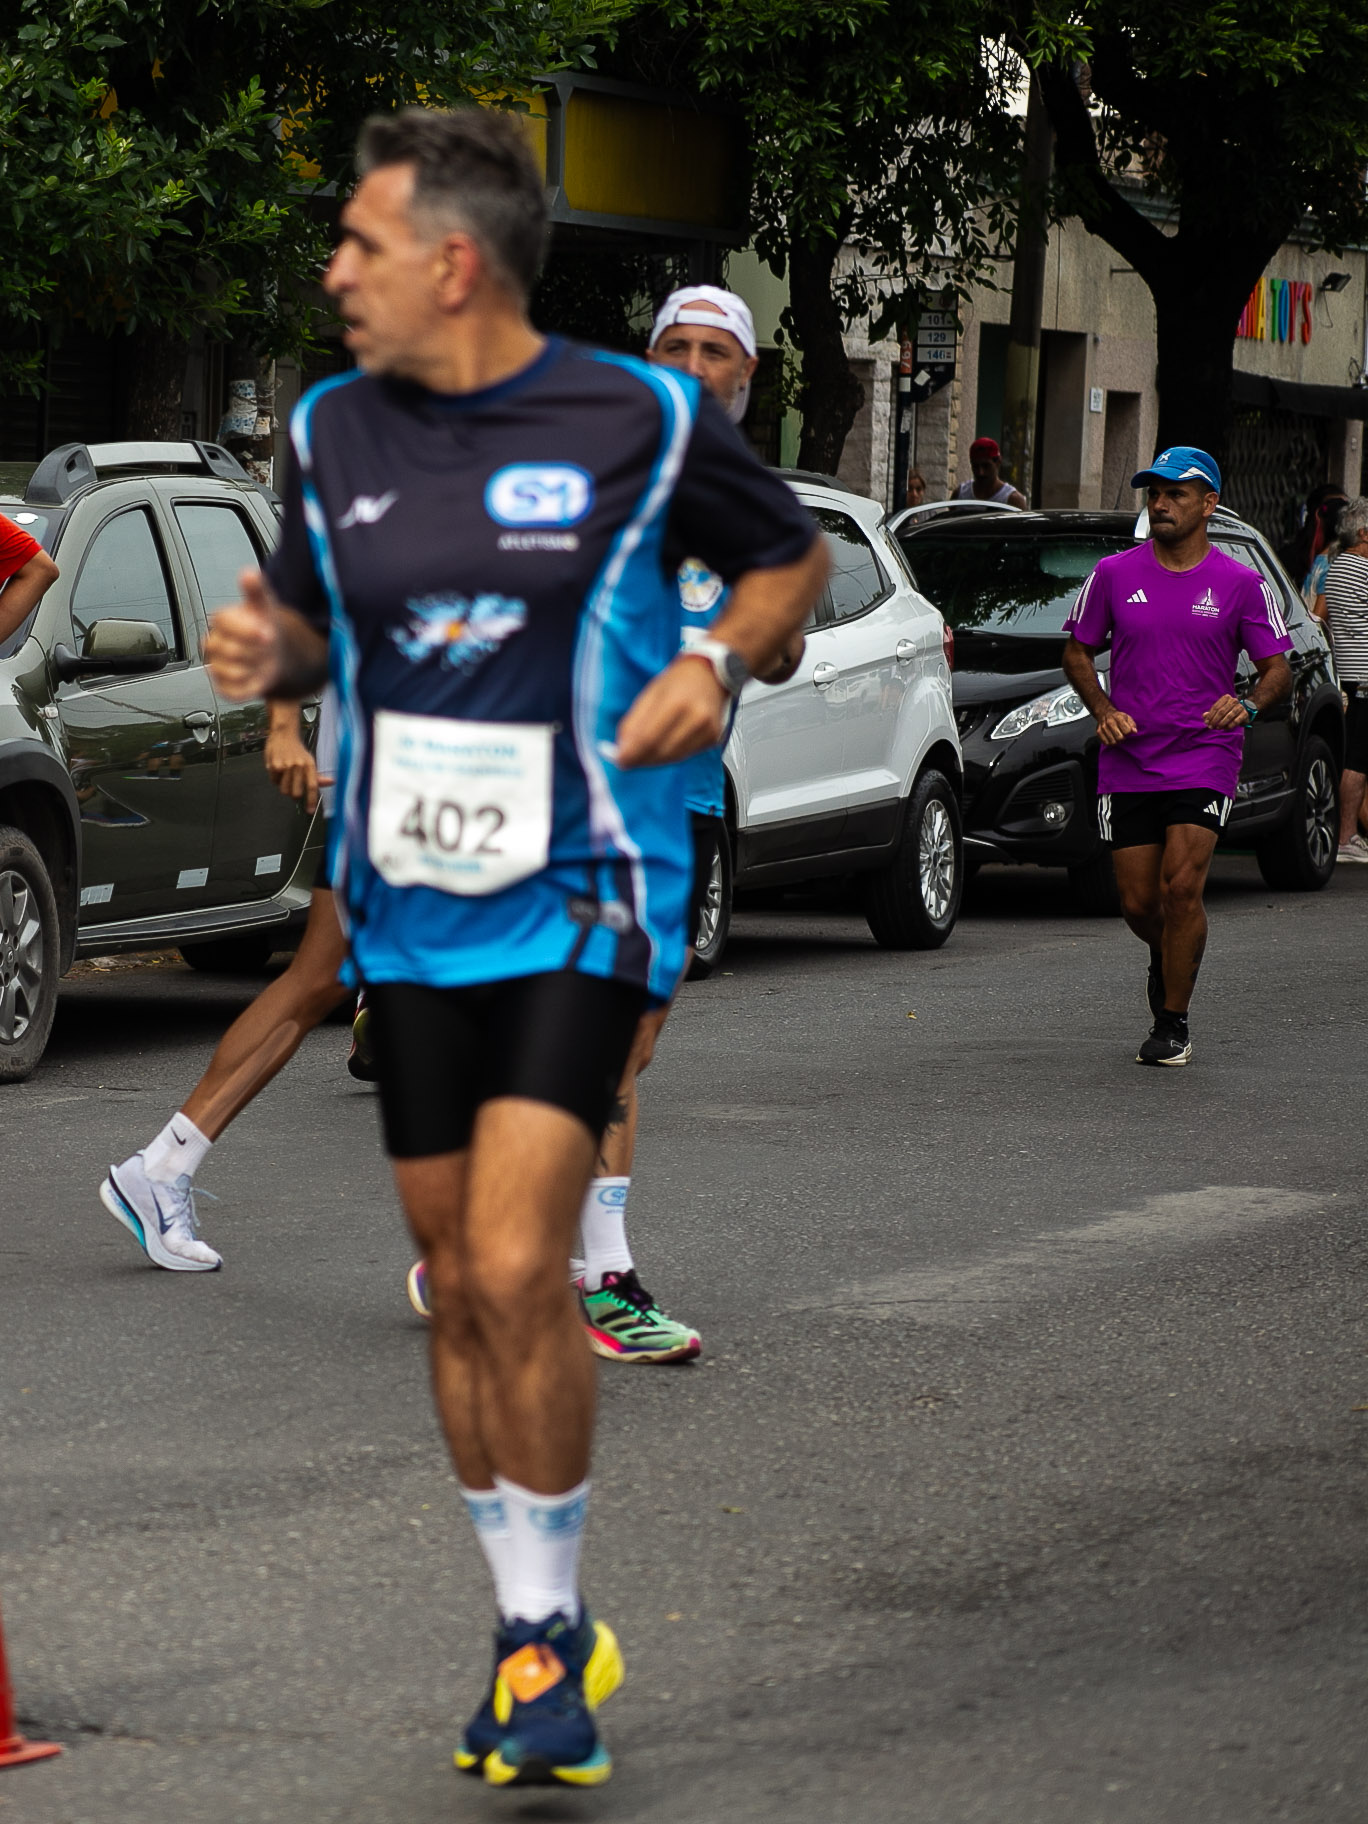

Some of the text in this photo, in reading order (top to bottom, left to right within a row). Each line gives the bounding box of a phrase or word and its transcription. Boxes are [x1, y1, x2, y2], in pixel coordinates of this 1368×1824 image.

[928, 315, 945, 325] 101
[928, 332, 946, 342] 129
[1192, 604, 1220, 613] MARATON
[400, 795, 506, 856] 402
